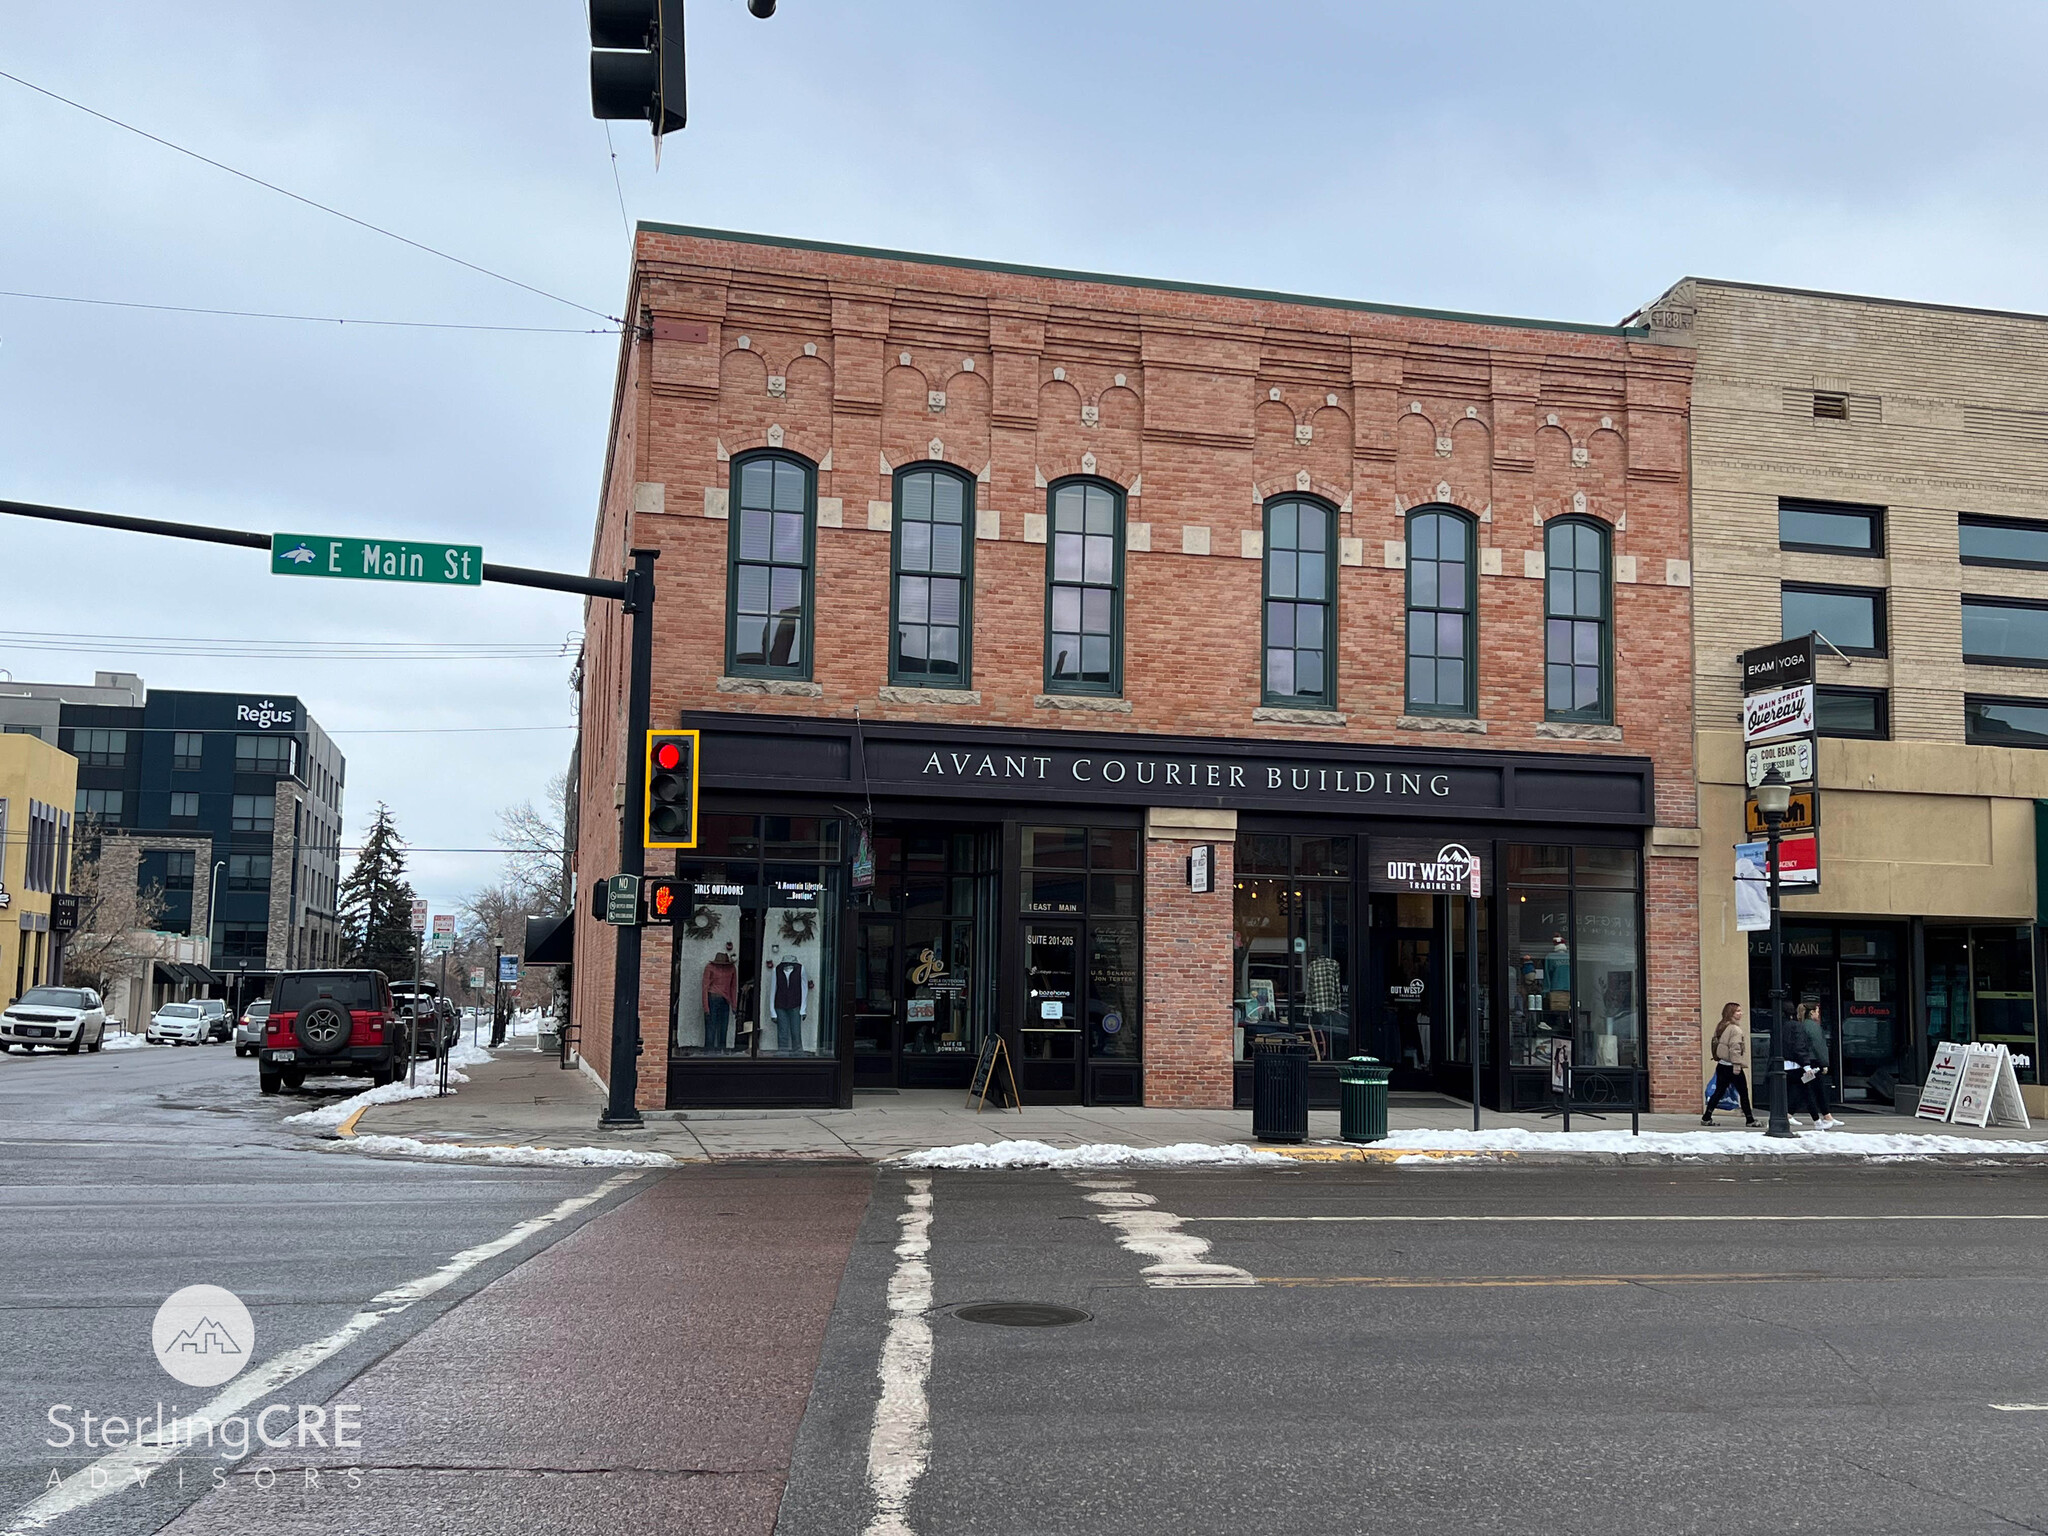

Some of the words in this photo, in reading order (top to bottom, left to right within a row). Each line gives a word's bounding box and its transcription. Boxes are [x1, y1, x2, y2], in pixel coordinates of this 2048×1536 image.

[328, 541, 343, 572] E
[363, 543, 424, 577] Main
[444, 548, 472, 580] St
[1748, 660, 1775, 676] EKAM
[1778, 654, 1806, 668] YOGA
[1758, 699, 1776, 711] MAIN
[1778, 688, 1804, 704] STREET
[237, 703, 293, 729] Regus
[1748, 697, 1807, 731] Overeasy
[1761, 749, 1776, 760] COOL
[1777, 744, 1797, 758] BEANS
[1763, 760, 1785, 771] ESPESSO
[1786, 759, 1795, 768] BAR
[922, 751, 1052, 780] AVANT
[1071, 758, 1246, 788] COURIER
[1266, 767, 1450, 797] BUILDING
[1387, 861, 1416, 880] OUT
[1420, 862, 1463, 881] WEST
[618, 877, 629, 889] NO
[782, 881, 804, 890] Mountain
[1410, 881, 1447, 890] TRADING
[711, 885, 744, 896] OUTDOORS
[1033, 903, 1052, 911] EAST
[1058, 904, 1077, 912] MAIN
[1027, 935, 1048, 945] SUITE
[1048, 935, 1074, 946] 201-205
[1758, 942, 1785, 954] EAT
[1788, 943, 1819, 955] MAIN
[912, 948, 945, 985] go
[1390, 986, 1402, 994] OUT
[1403, 986, 1421, 994] WEST
[1850, 1005, 1867, 1015] Cool
[1868, 1006, 1890, 1015] Beans
